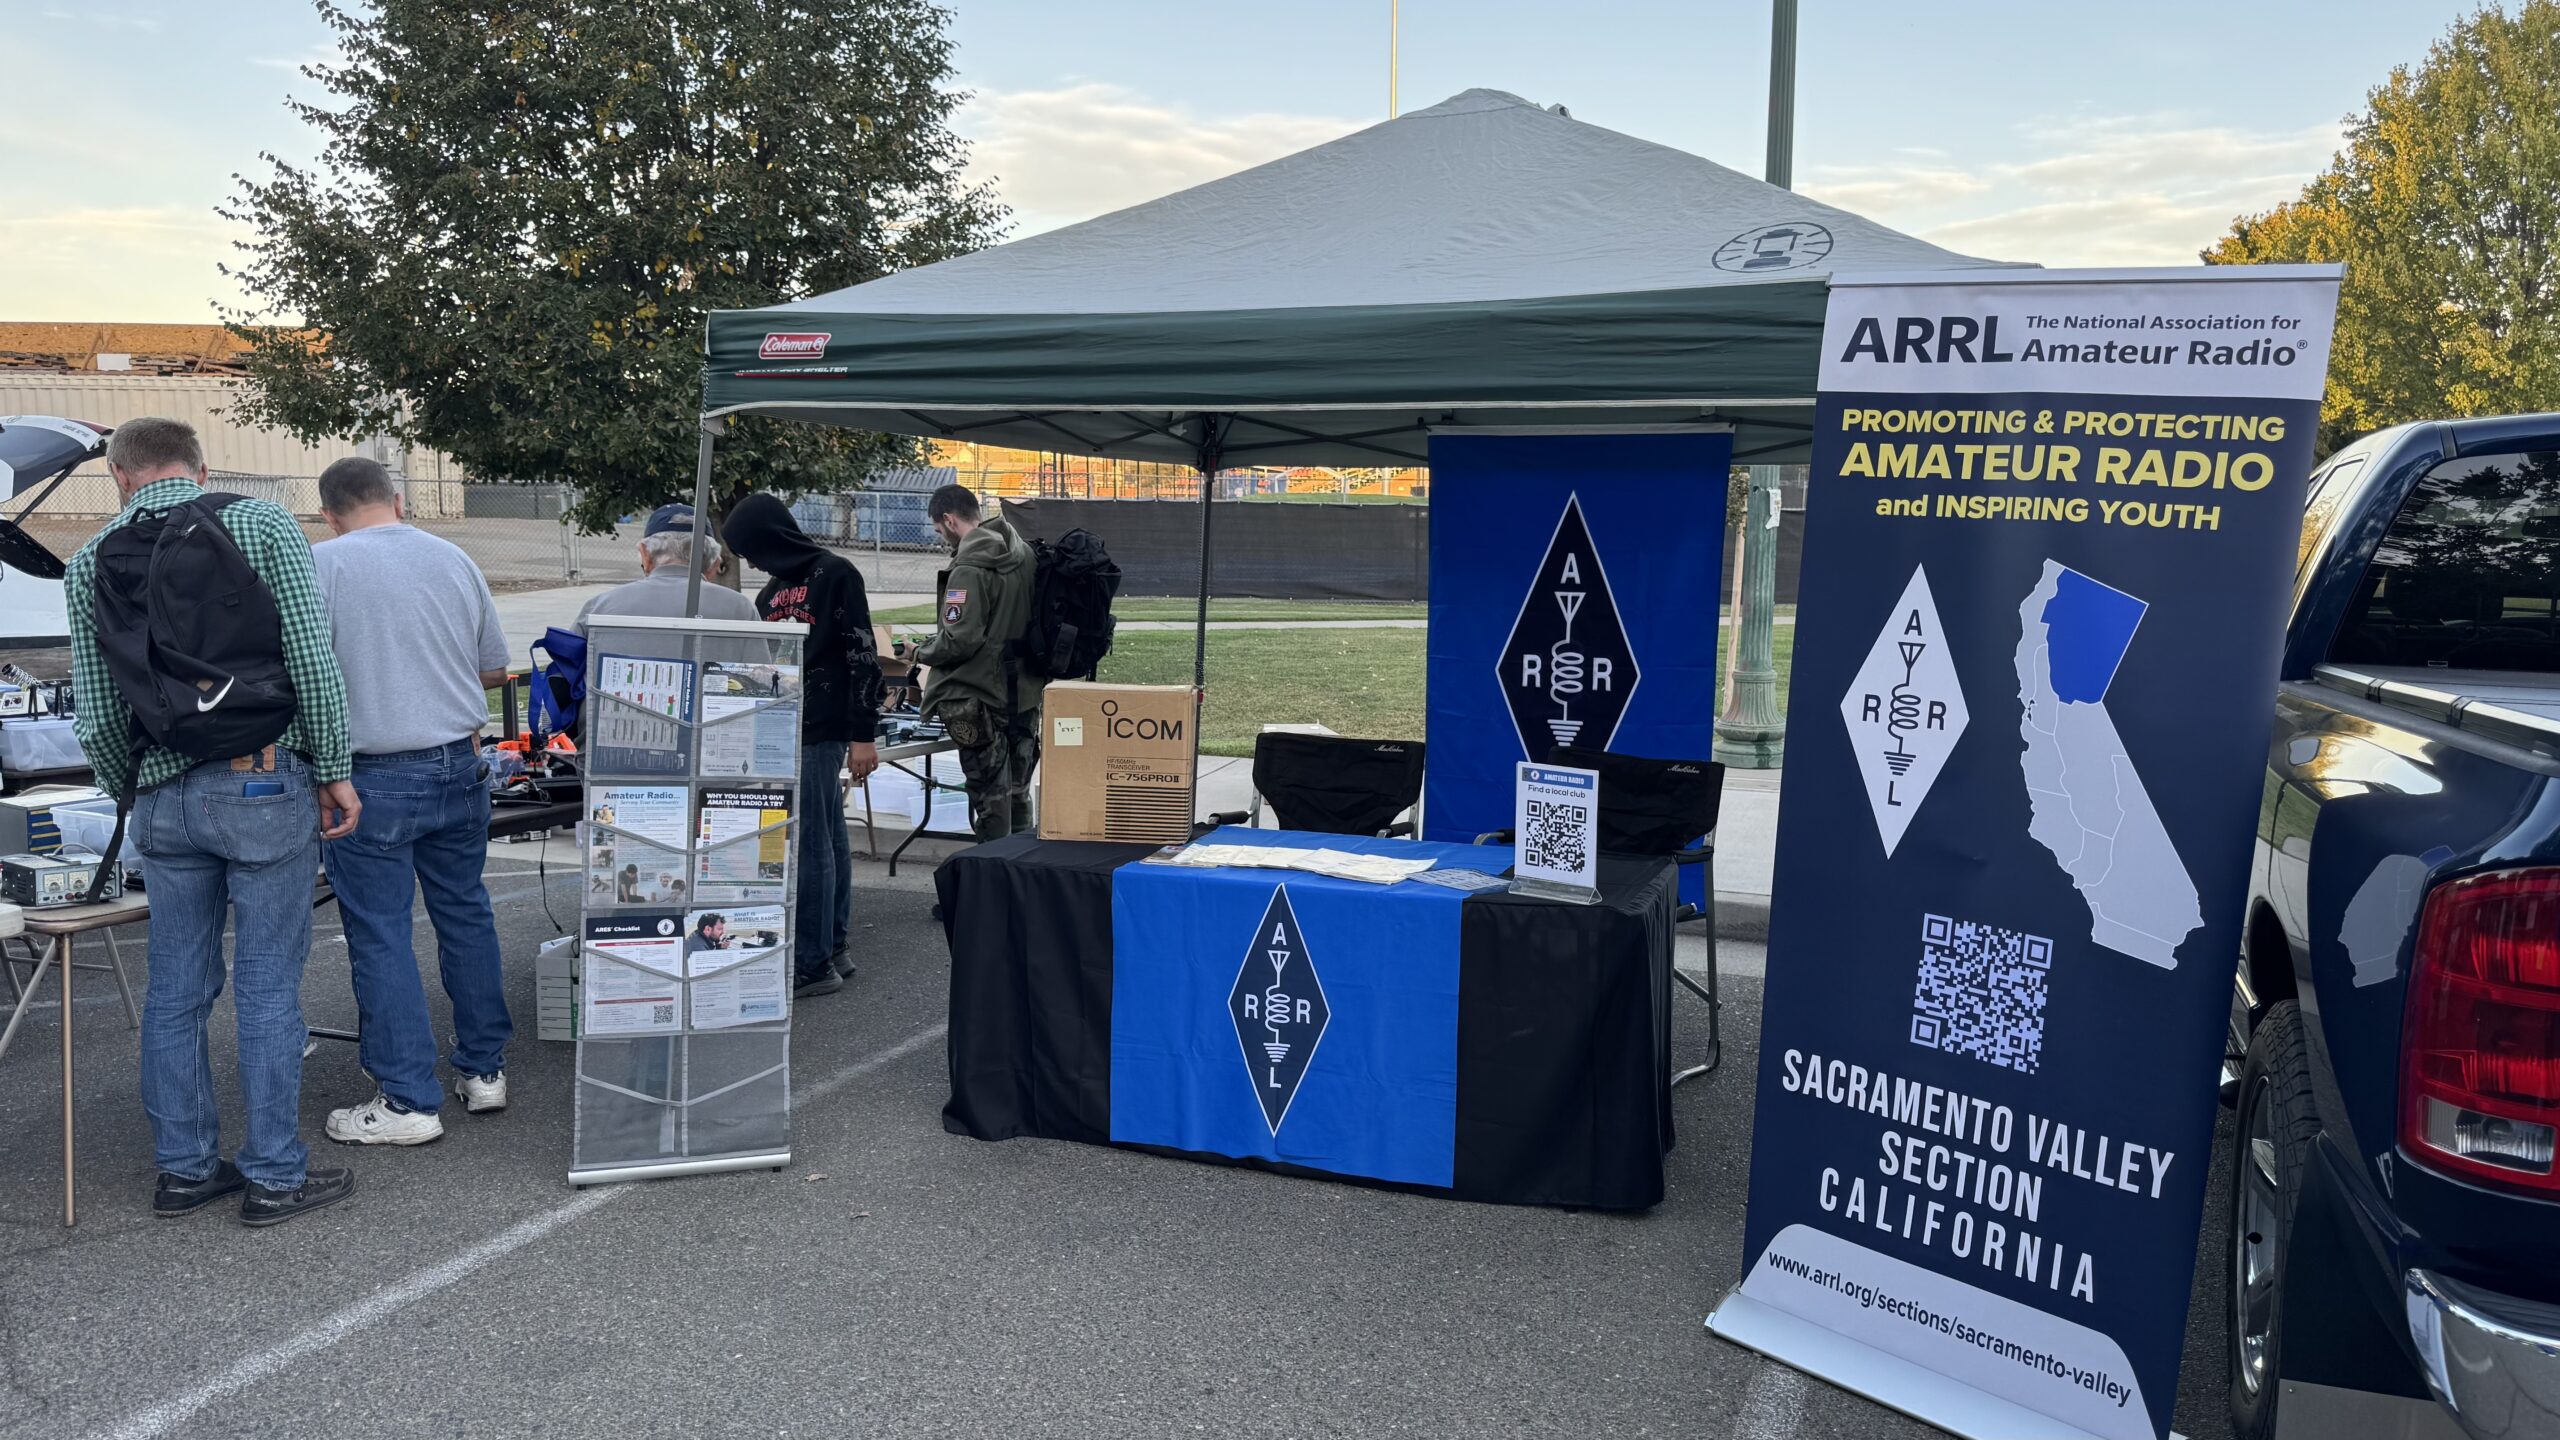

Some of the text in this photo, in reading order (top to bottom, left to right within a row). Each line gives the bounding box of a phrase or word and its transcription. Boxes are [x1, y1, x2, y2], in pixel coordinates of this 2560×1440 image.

[1840, 315, 2014, 364] ARRL
[2026, 315, 2300, 331] The National Association for
[765, 337, 813, 352] Coleman
[2021, 339, 2179, 365] Amateur
[1841, 408, 2286, 442] PROMOTING & PROTECTING
[1839, 442, 2275, 492] AMATEUR RADIO
[1875, 494, 2221, 531] and INSPIRING YOUTH
[1560, 552, 1581, 585] A
[1904, 609, 1923, 636] A
[1528, 784, 1544, 794] Find
[1552, 787, 1569, 796] local
[1569, 790, 1586, 798] club
[1544, 773, 1585, 785] AMATEUR RADIO
[1271, 922, 1288, 946] A
[1782, 1049, 2175, 1199] SACRAMENTO VALLEY
[1879, 1131, 2043, 1223] SECTION
[1819, 1167, 2095, 1304] CALIFORNIA
[1768, 1250, 2132, 1408] www.arrl.org/sections/sacramento-valley
